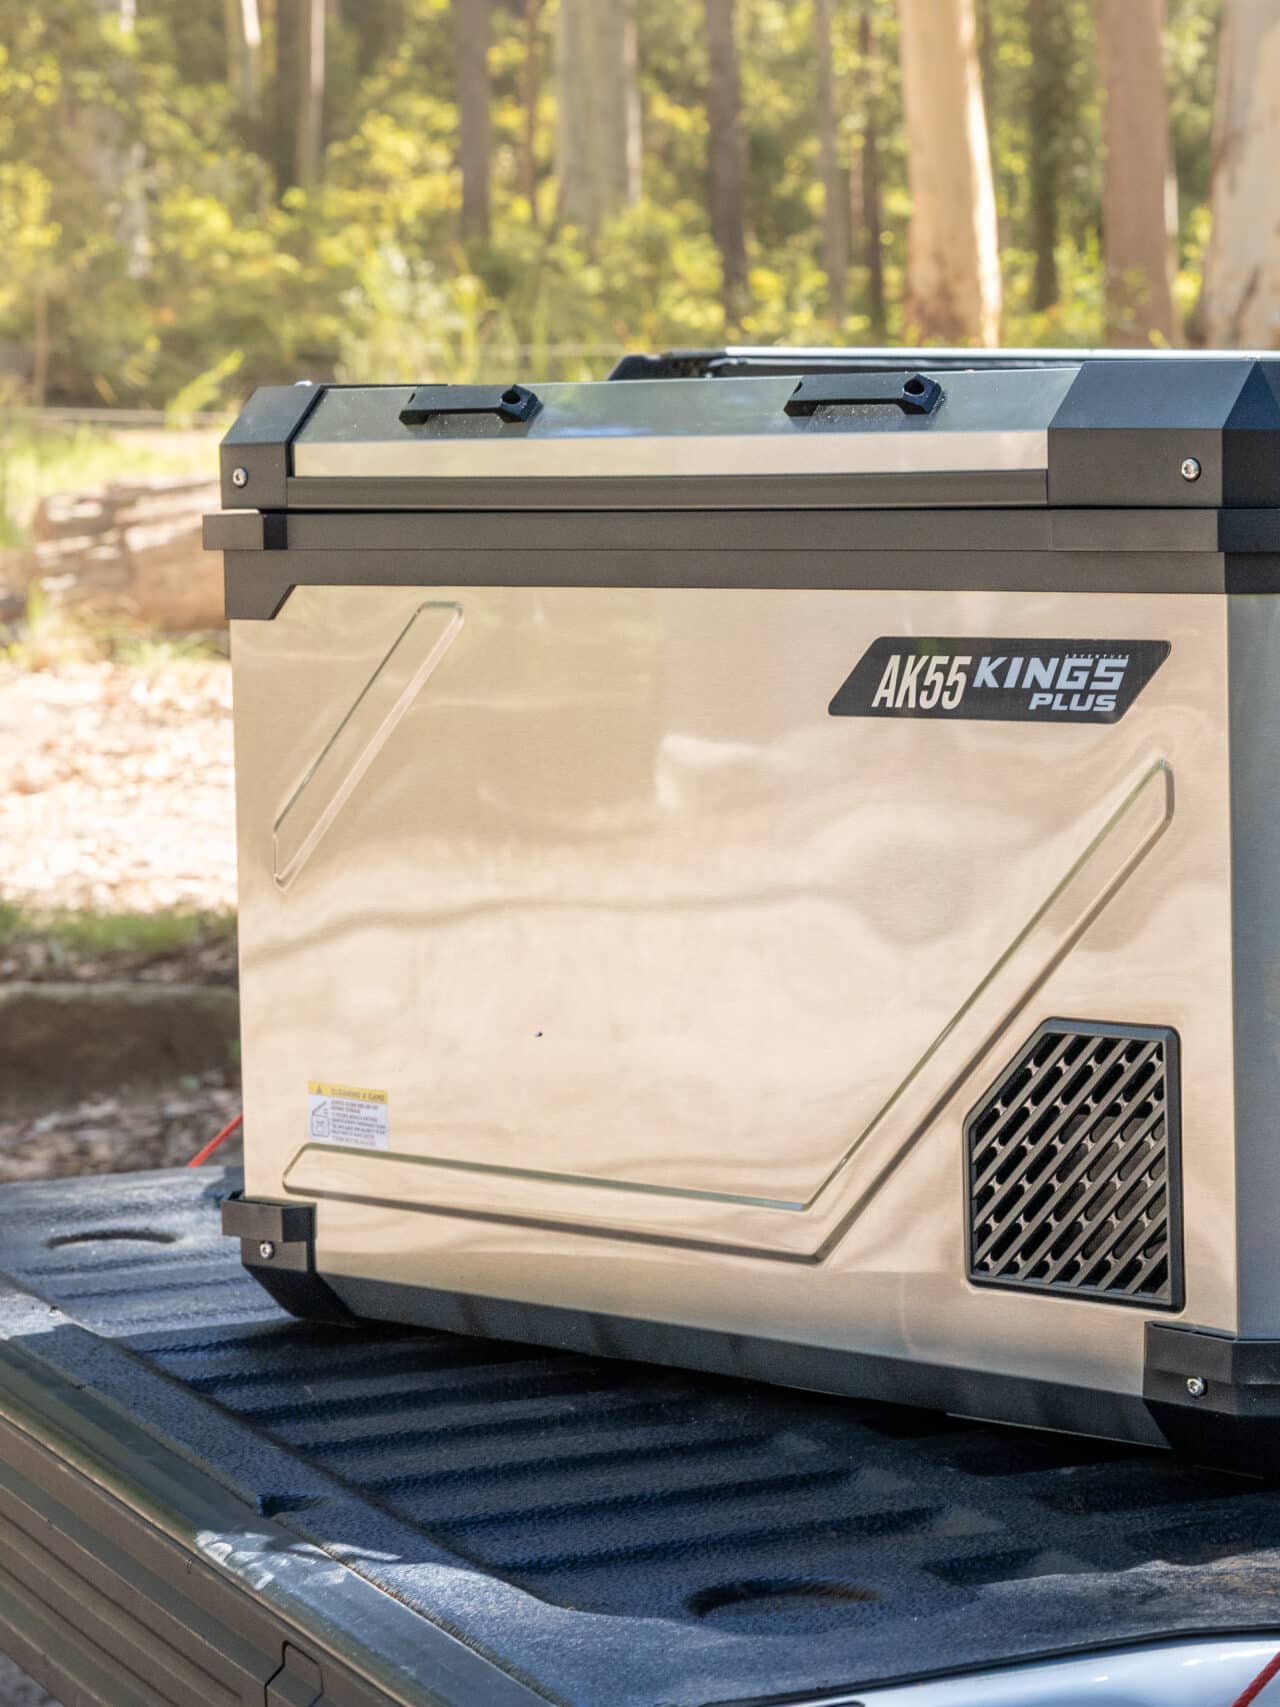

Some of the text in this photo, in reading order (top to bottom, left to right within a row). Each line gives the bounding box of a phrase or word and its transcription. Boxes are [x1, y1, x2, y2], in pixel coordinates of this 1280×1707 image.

[871, 654, 1128, 710] AK55 KINGS
[1028, 692, 1117, 712] PLUS
